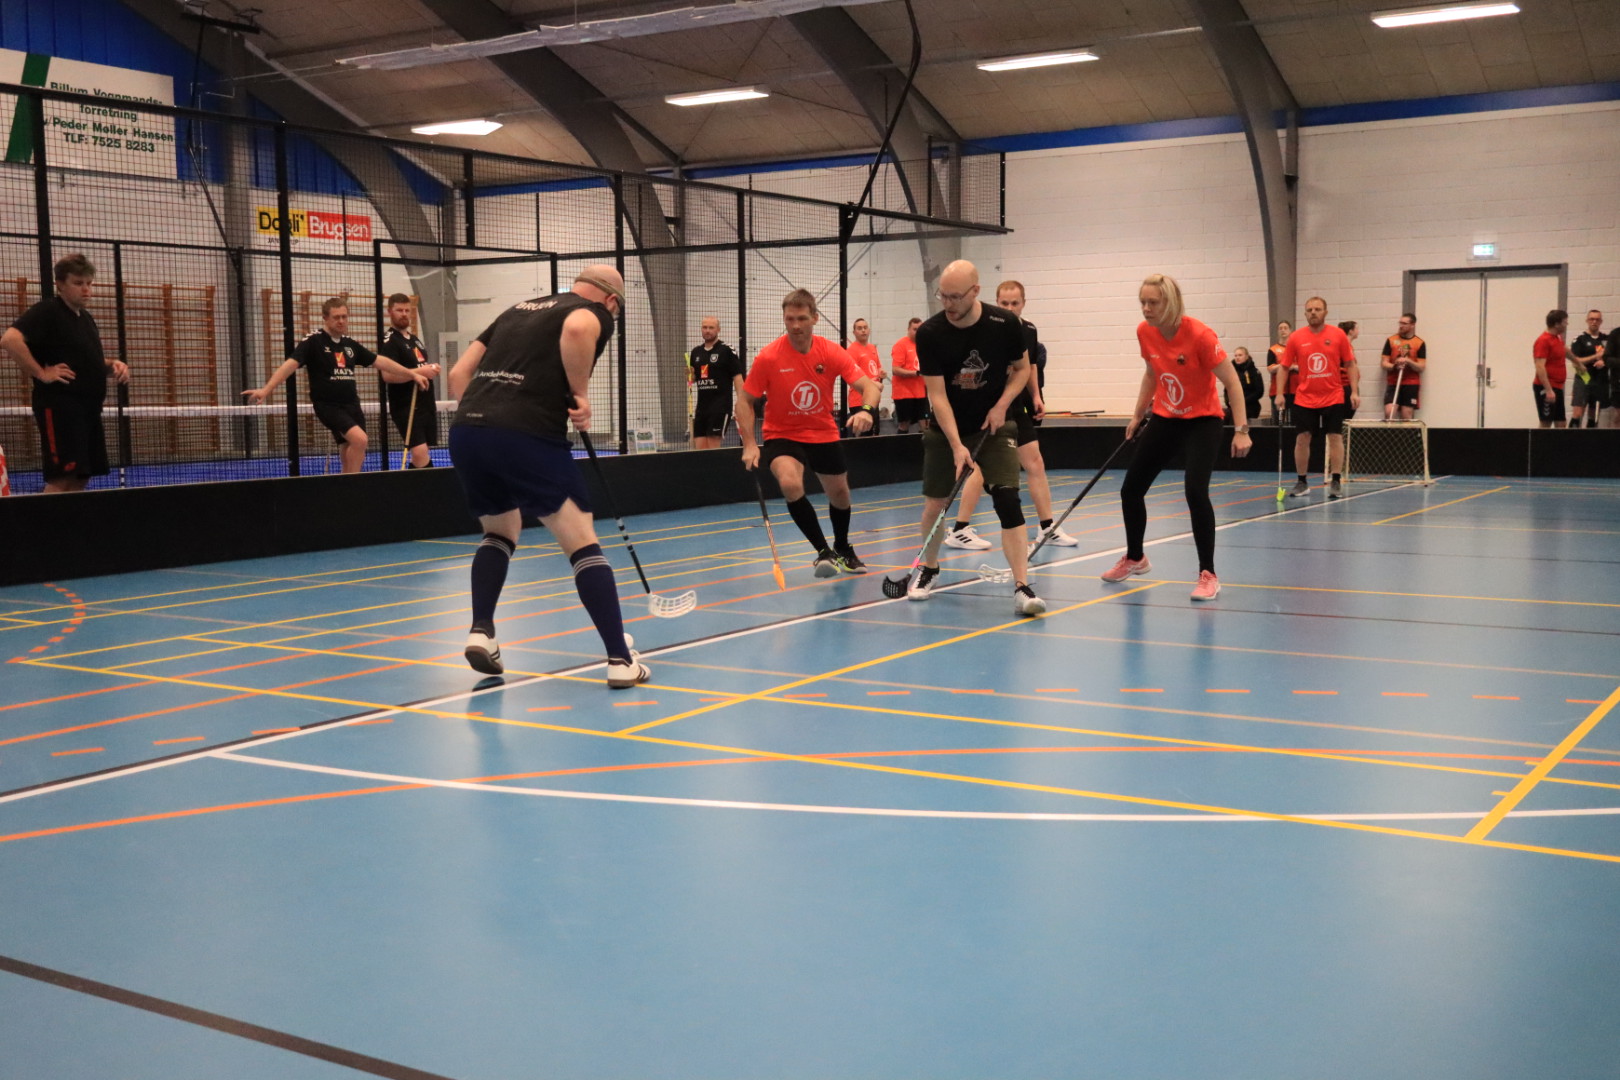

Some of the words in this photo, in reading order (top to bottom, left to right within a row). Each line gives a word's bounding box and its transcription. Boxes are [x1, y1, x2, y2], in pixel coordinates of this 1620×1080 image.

[80, 103, 137, 122] forretning
[53, 116, 88, 131] Peder
[132, 127, 174, 143] Hansen
[62, 132, 88, 145] TLF:
[92, 135, 122, 149] 7525
[125, 140, 156, 153] 8283
[309, 215, 368, 240] Brugsen
